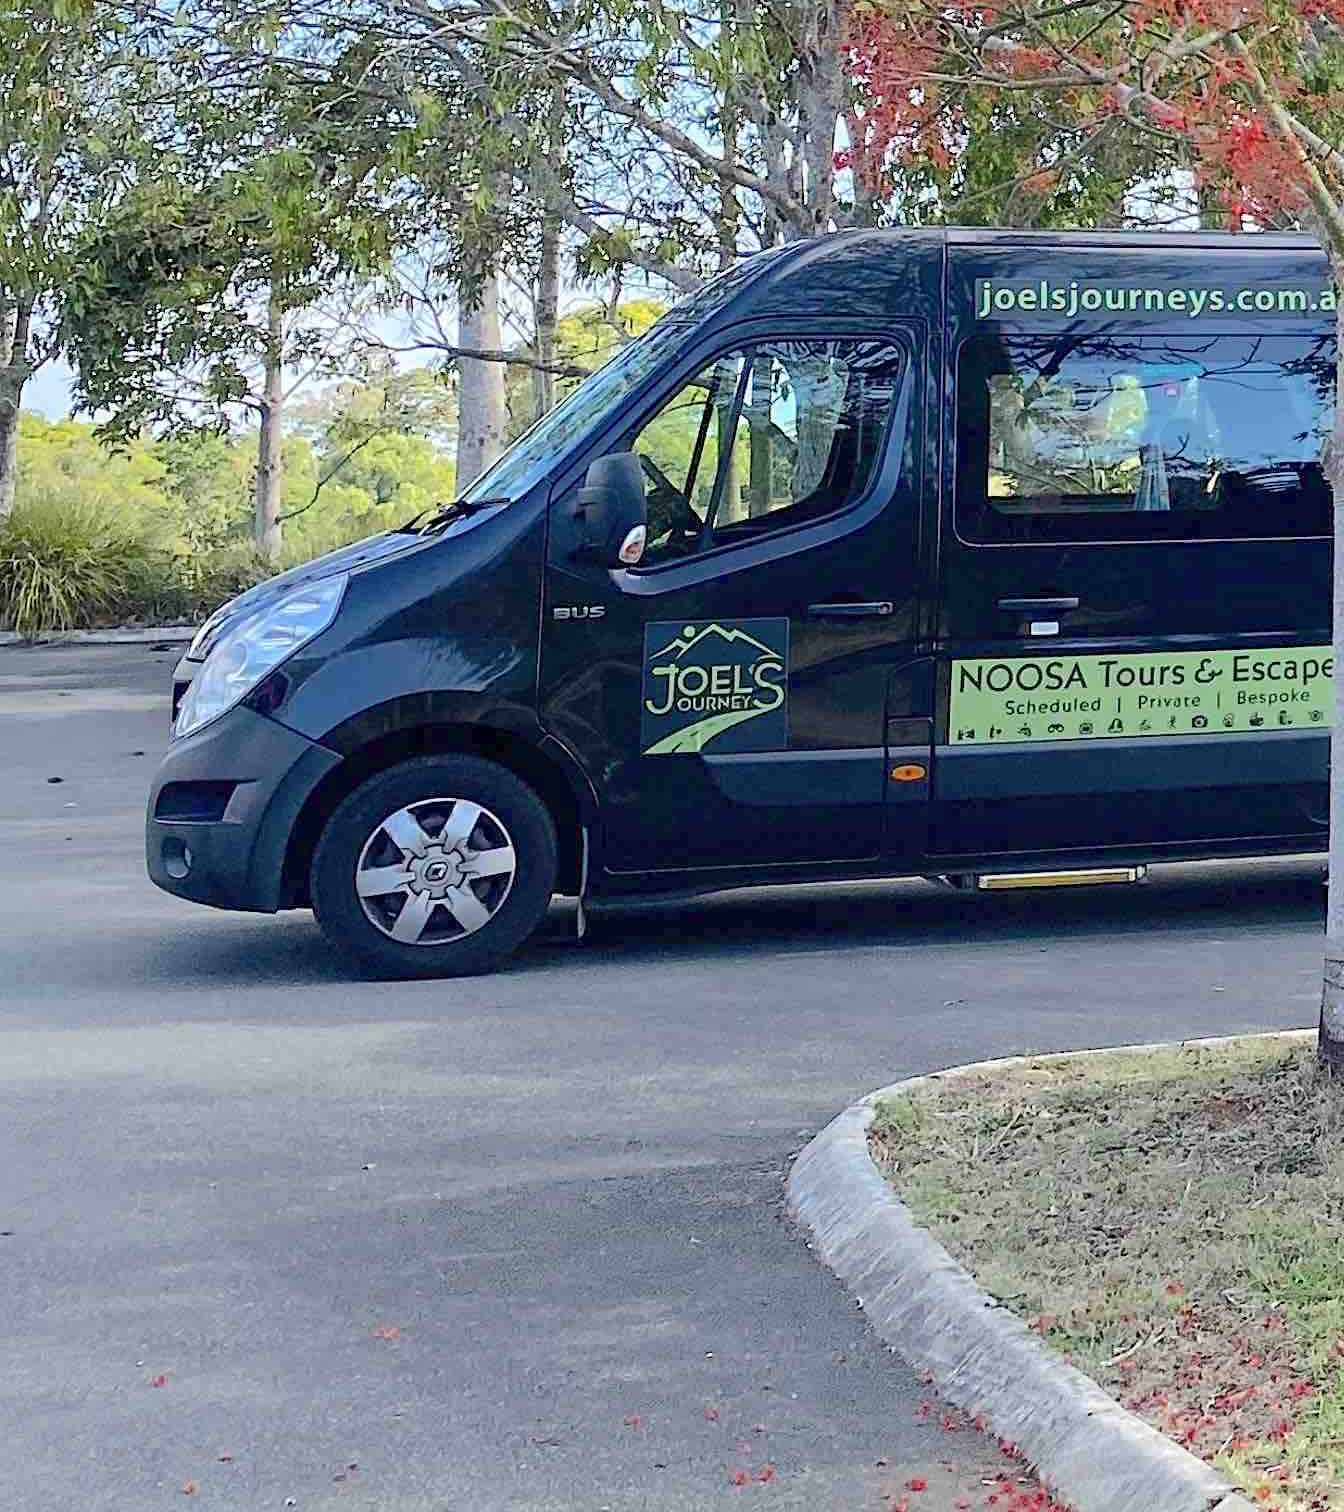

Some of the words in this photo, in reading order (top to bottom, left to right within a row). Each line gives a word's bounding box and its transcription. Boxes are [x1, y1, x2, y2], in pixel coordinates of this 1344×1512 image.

[978, 281, 1336, 318] joelsjourneys.com.a
[553, 605, 607, 621] BUS
[959, 661, 1088, 693] NOOSA
[1098, 659, 1185, 688] Tours
[1194, 657, 1224, 684] &
[1005, 696, 1102, 716] Scheduled
[1138, 693, 1201, 710] Private
[1236, 688, 1311, 705] Bespoke
